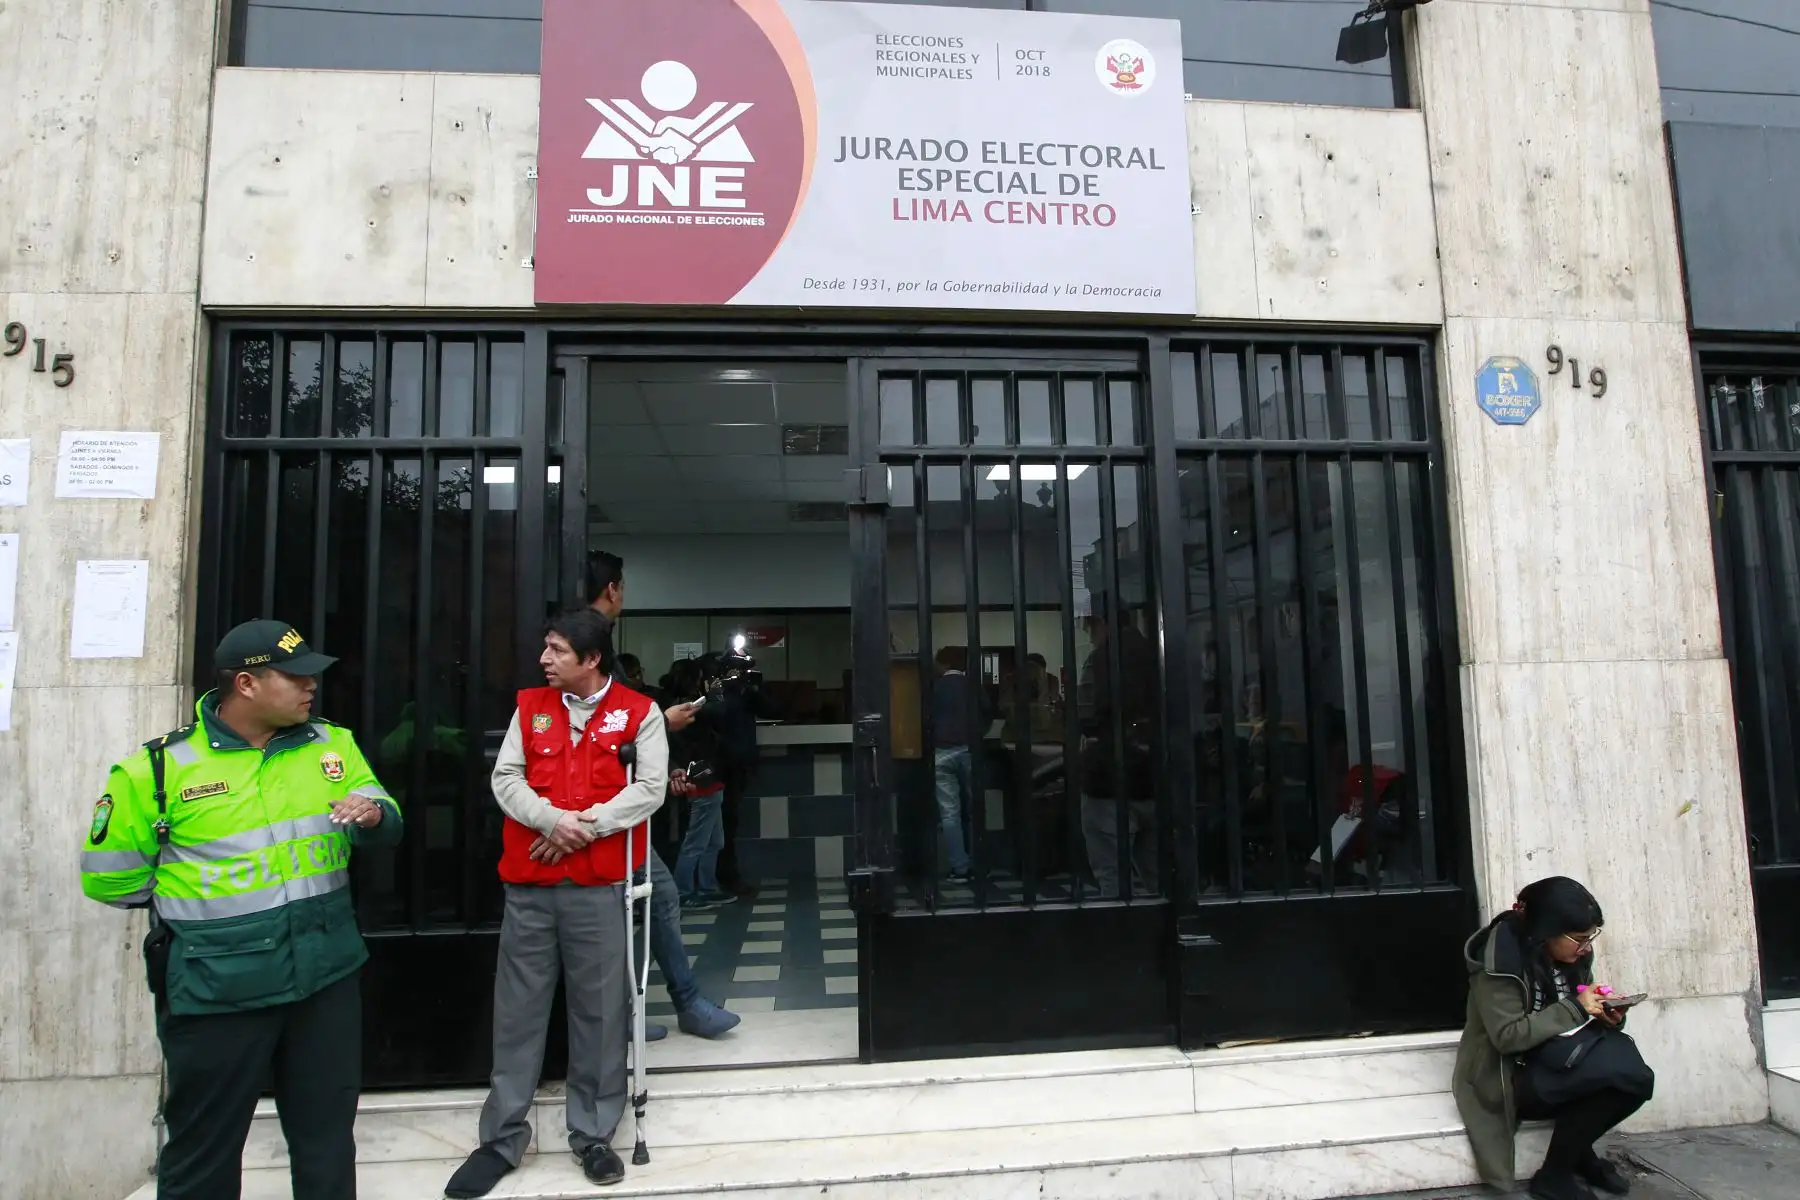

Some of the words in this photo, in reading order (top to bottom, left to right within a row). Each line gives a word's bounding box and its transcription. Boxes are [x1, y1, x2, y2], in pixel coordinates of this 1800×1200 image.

[875, 34, 964, 48] ELECCIONES
[875, 50, 967, 64] REGIONALES
[971, 53, 980, 65] Y
[1015, 49, 1046, 61] OCT
[875, 66, 973, 80] MUNICIPALES
[1015, 64, 1051, 77] 2018
[834, 136, 969, 163] JURADO
[980, 141, 1166, 170] ELECTORAL
[586, 164, 746, 208] JNE
[898, 167, 1047, 195] ESPECIAL
[1058, 173, 1100, 197] DE
[567, 214, 614, 223] JURADO
[616, 215, 674, 224] NACIONAL
[677, 215, 692, 225] DE
[695, 216, 765, 226] ELECCIONES
[892, 197, 973, 223] LIMA
[983, 200, 1117, 227] CENTRO
[803, 277, 846, 290] Desde
[852, 278, 891, 293] 1931,
[896, 280, 921, 293] por
[925, 280, 938, 291] la
[943, 280, 1049, 294] Gobernabilidad
[1053, 285, 1061, 296] y
[1065, 283, 1078, 295] la
[1082, 284, 1162, 298] Democracia
[4, 322, 74, 388] 915
[1546, 344, 1607, 399] 919
[244, 653, 272, 665] PERU
